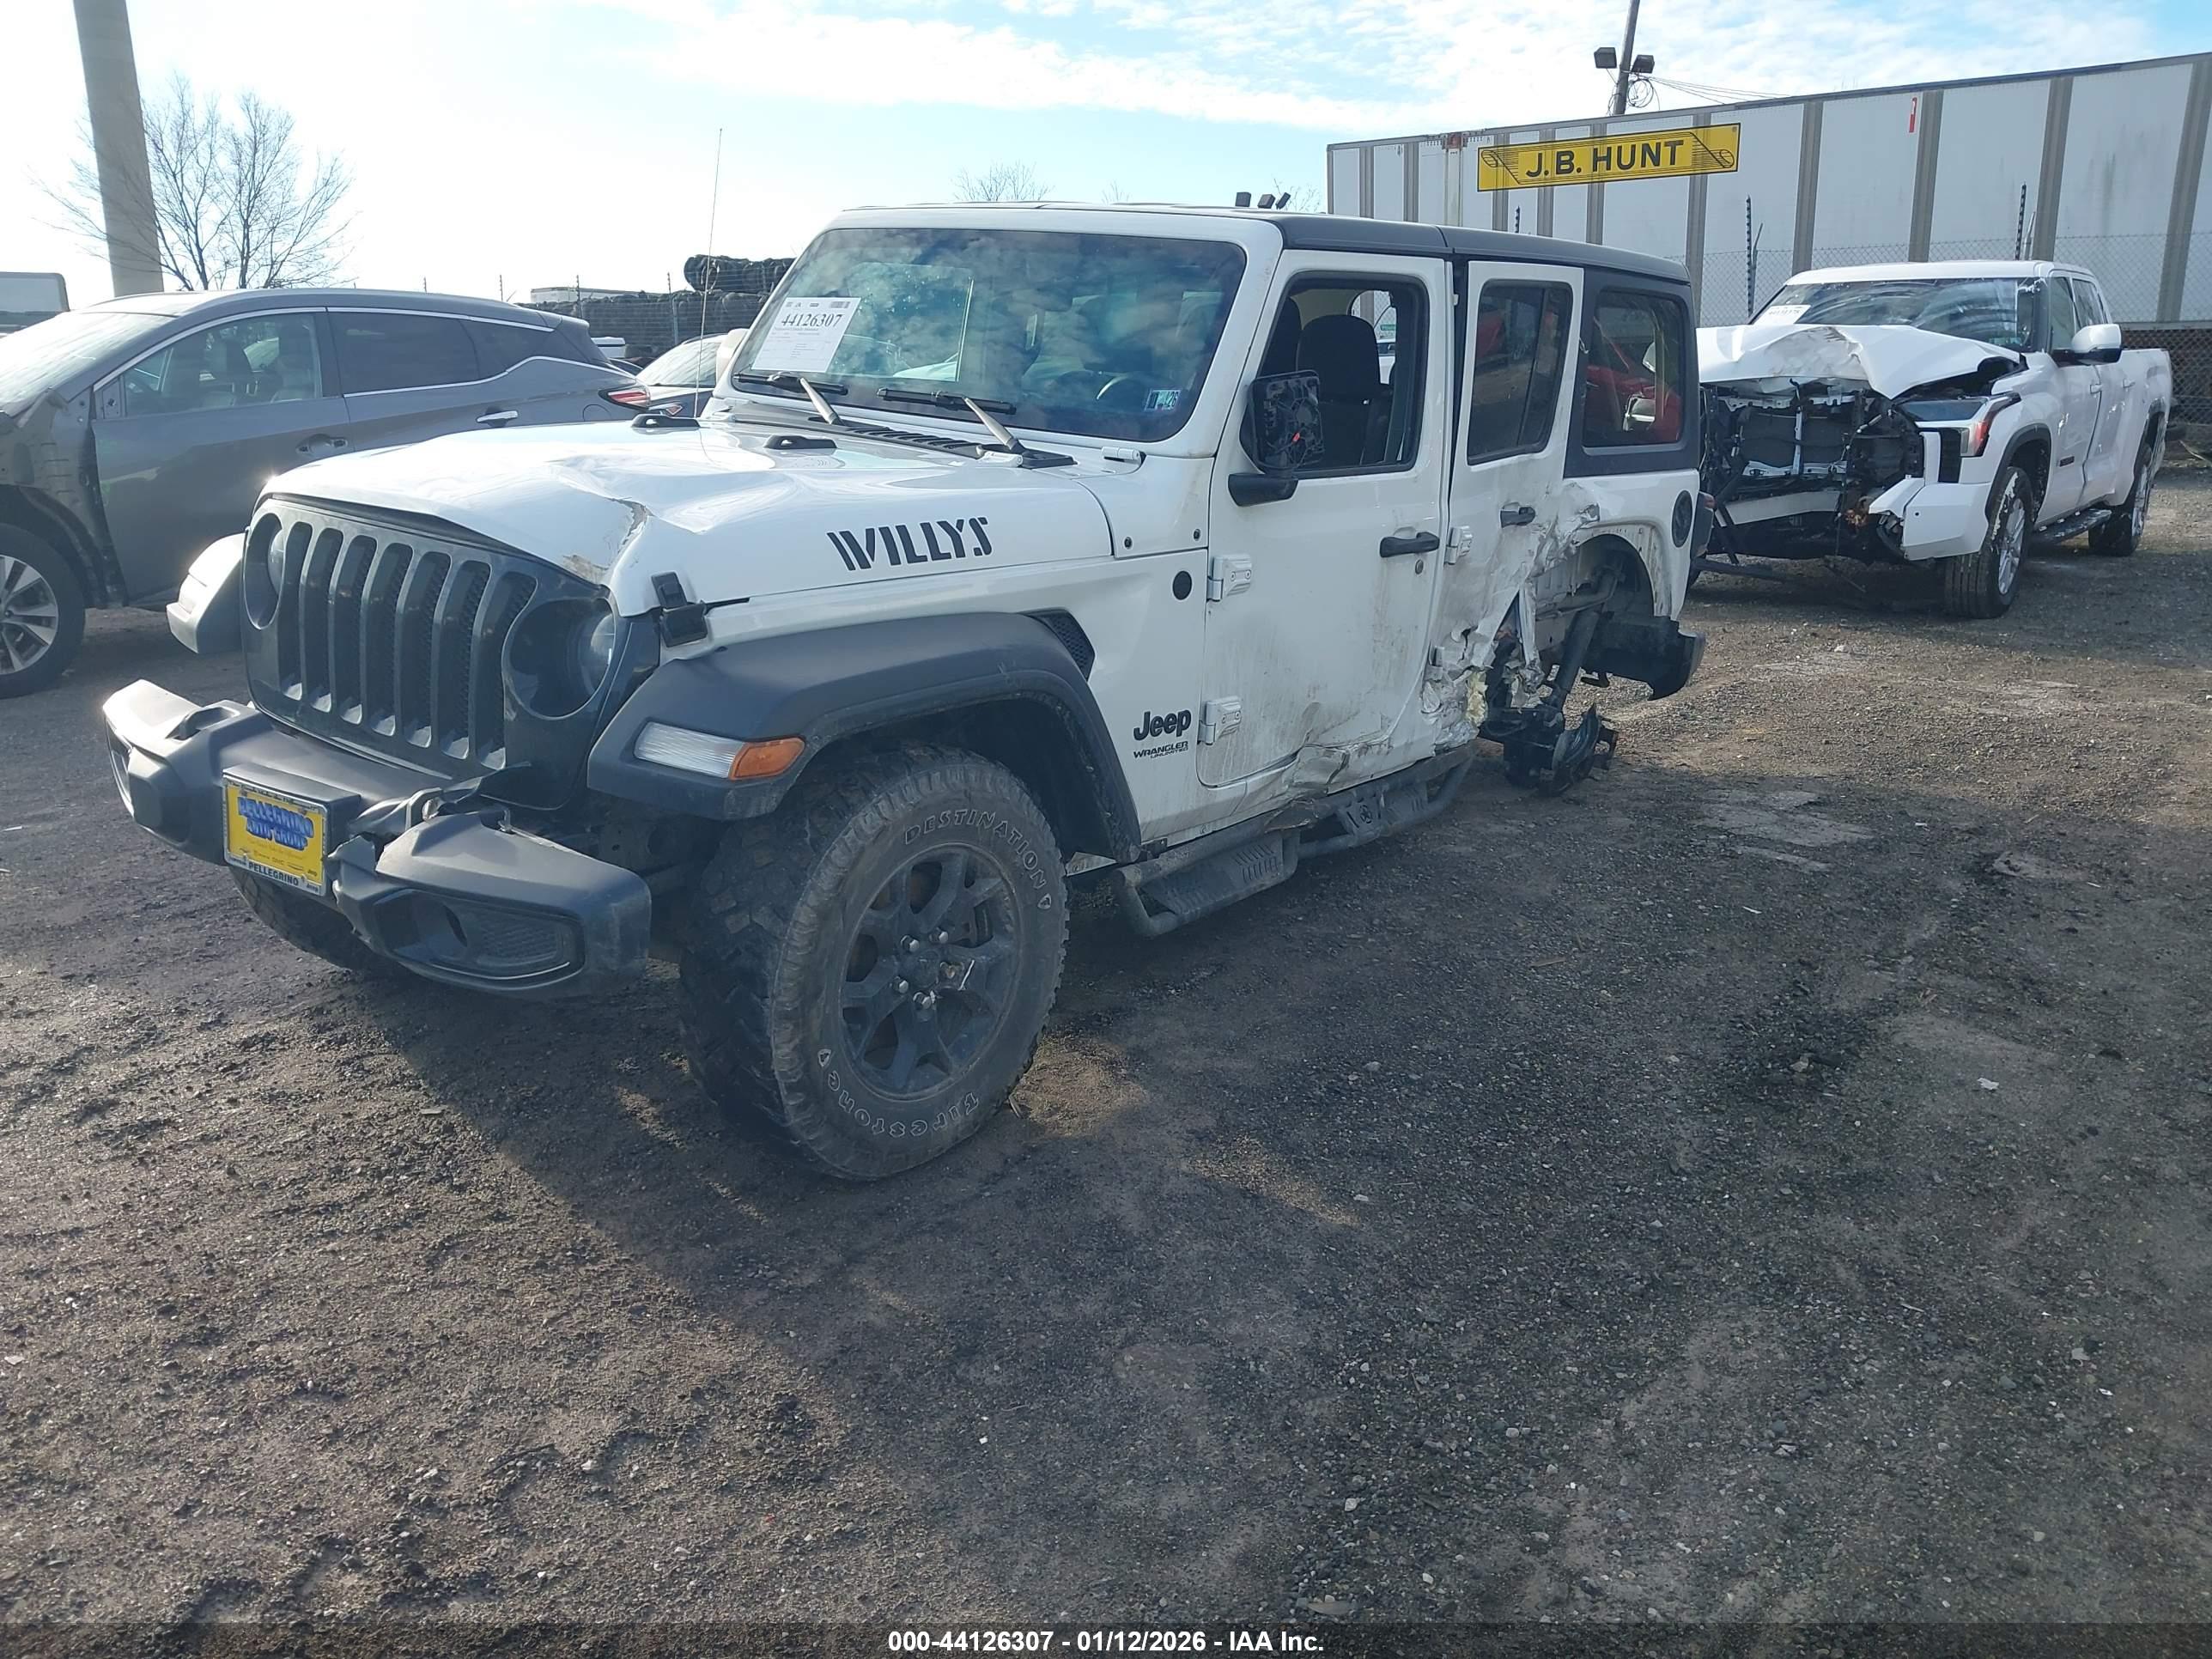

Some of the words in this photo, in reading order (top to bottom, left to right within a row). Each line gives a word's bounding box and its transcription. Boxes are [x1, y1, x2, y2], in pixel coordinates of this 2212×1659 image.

[1526, 150, 1582, 177] J.B.
[1593, 140, 1684, 172] HUNT
[781, 313, 844, 327] 44126307
[827, 517, 992, 570] WILLYS
[1133, 710, 1192, 741] Jeep
[1133, 740, 1188, 759] WRANGLER
[238, 797, 313, 838] PELLEGRINO
[905, 809, 1048, 890] DESTINATION
[248, 861, 299, 886] PELLEGRINO
